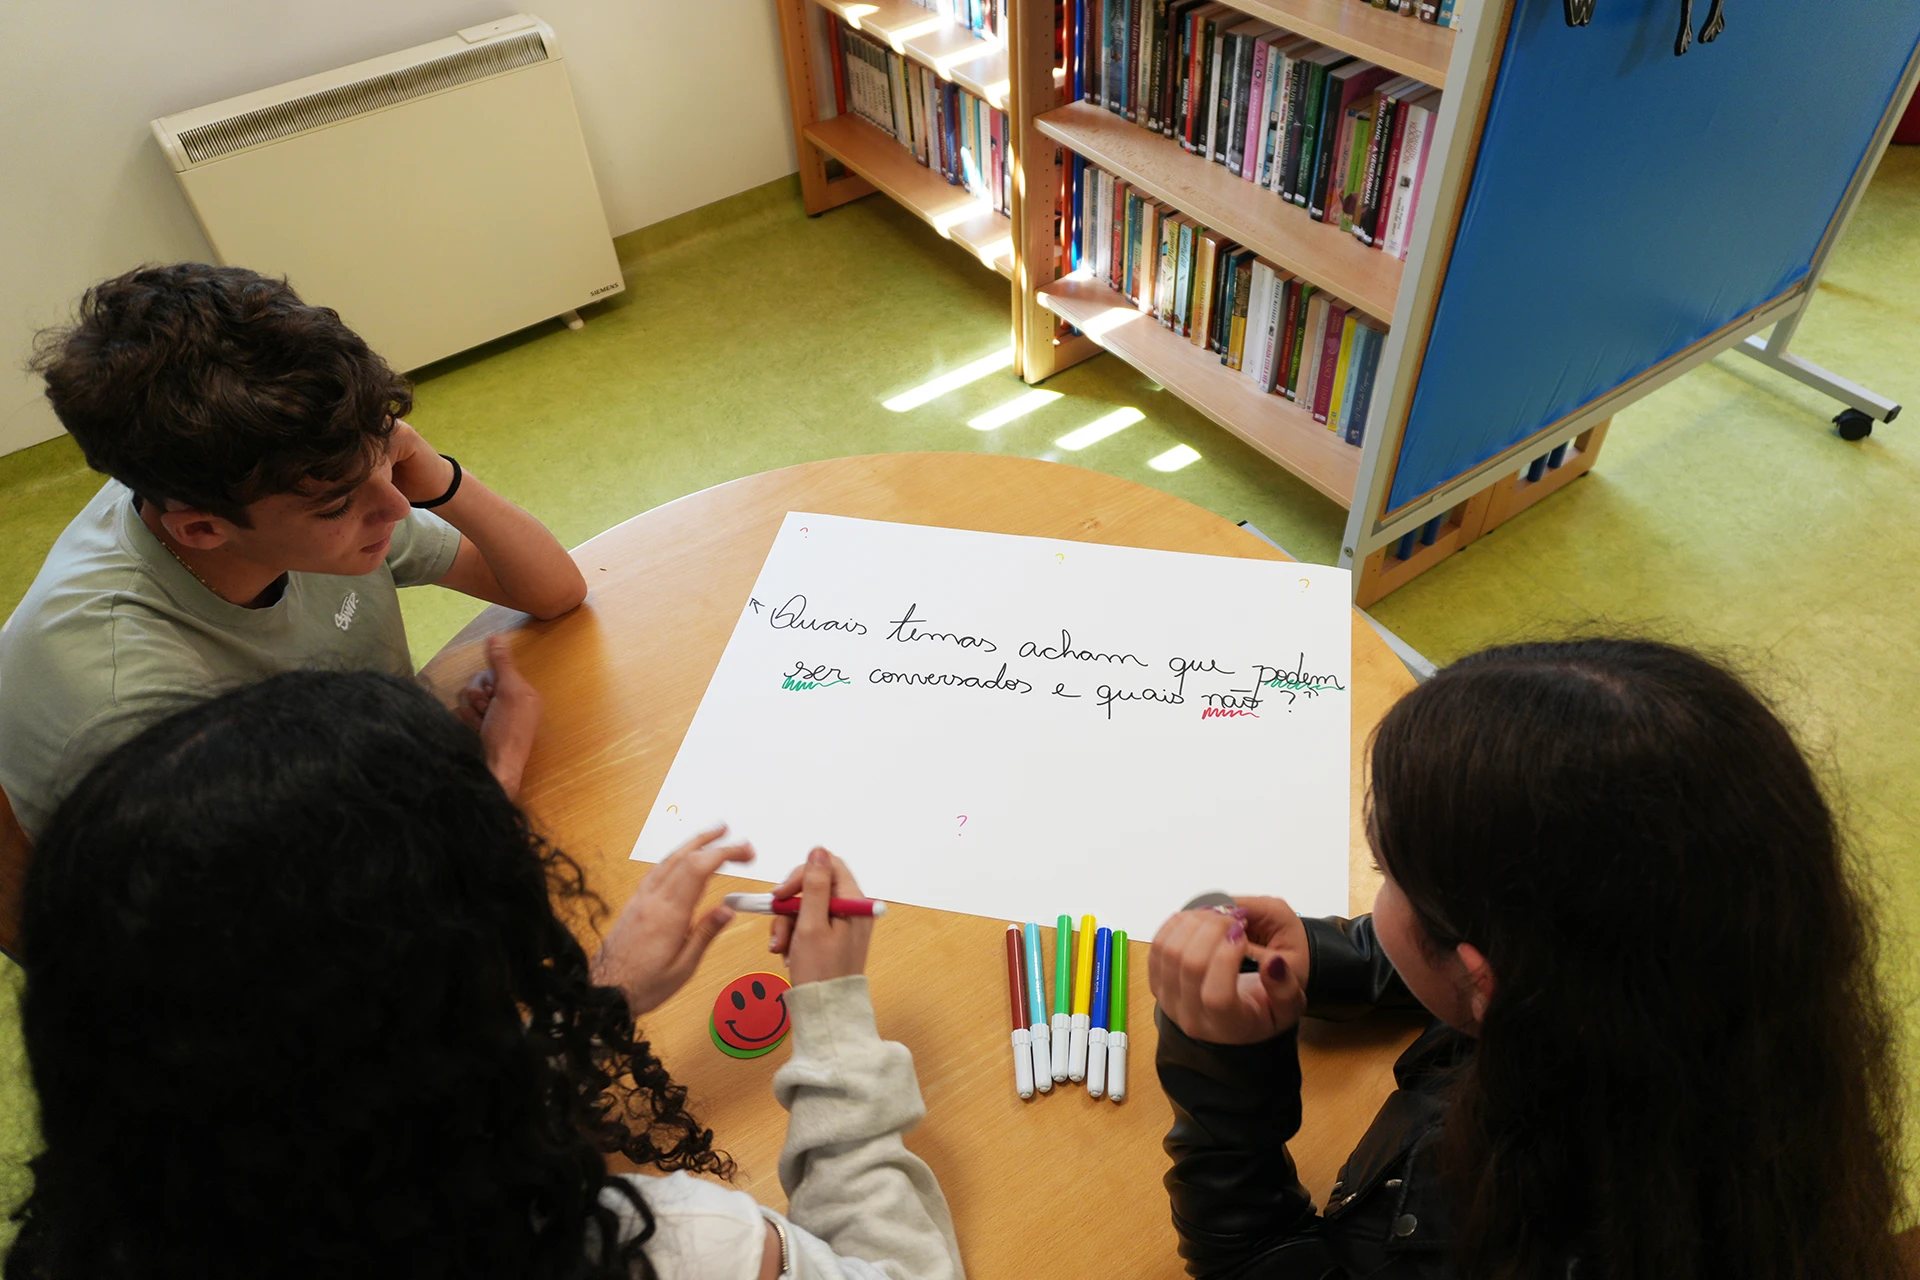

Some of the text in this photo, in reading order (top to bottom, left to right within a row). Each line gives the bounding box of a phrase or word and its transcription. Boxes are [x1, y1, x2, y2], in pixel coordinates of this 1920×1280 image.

[1253, 44, 1264, 87] AMOR
[1374, 117, 1383, 140] KANG
[1378, 98, 1386, 116] HAN
[1363, 153, 1377, 204] VEGETARIANA
[590, 282, 619, 296] SIEMENS
[886, 602, 997, 652] temas
[1018, 628, 1149, 667] acham
[1168, 656, 1236, 696] que
[1252, 651, 1346, 711] podem
[783, 660, 850, 682] ser
[869, 662, 1033, 694] conversados
[1052, 682, 1082, 698] e
[1096, 684, 1185, 720] quais
[1201, 689, 1258, 709] não
